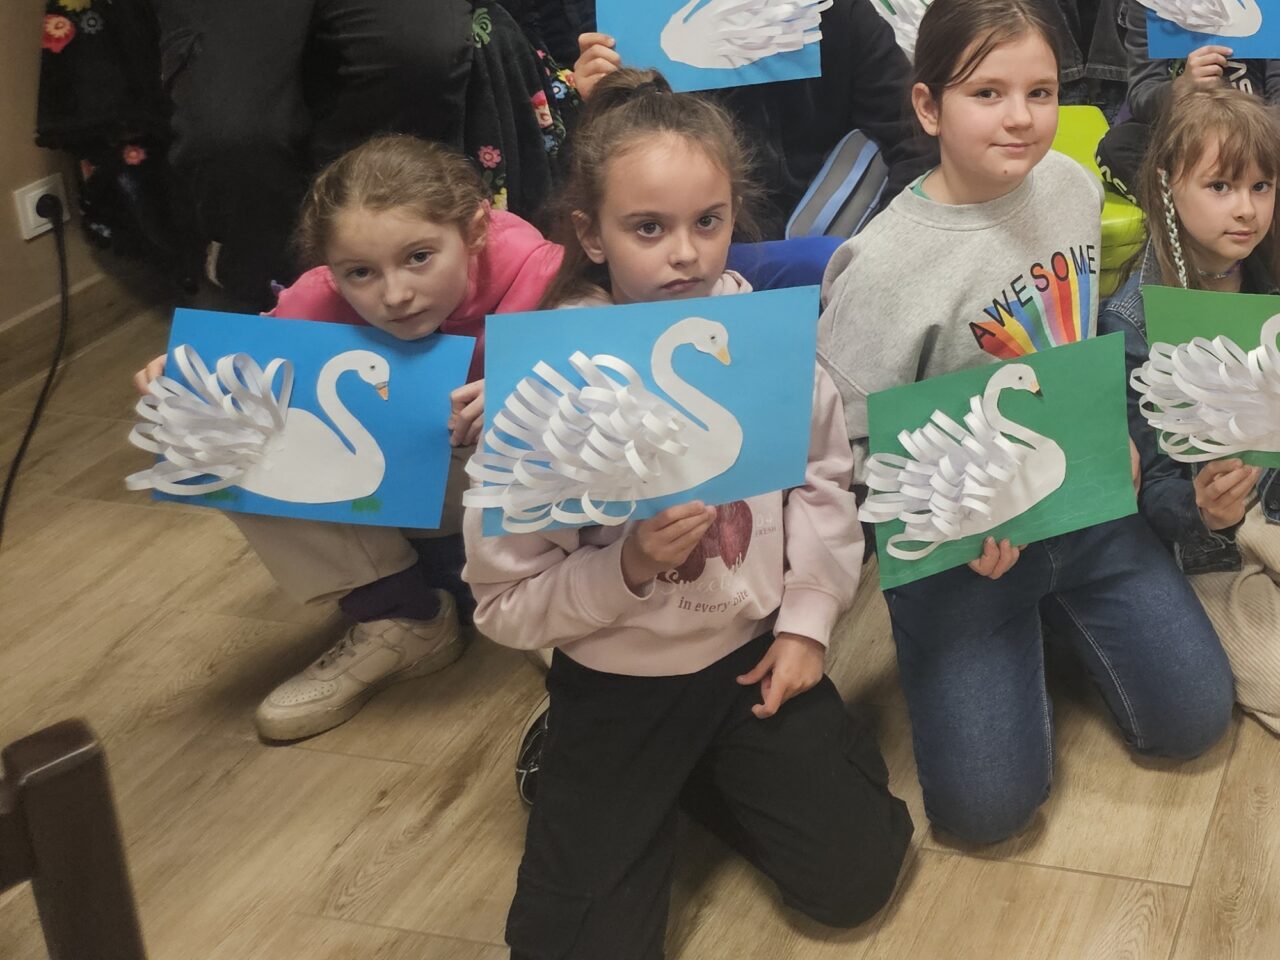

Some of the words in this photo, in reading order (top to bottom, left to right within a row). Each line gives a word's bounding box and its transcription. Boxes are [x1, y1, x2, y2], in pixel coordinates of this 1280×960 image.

[969, 244, 1096, 349] AWESOME
[678, 595, 692, 611] in
[694, 600, 731, 613] every
